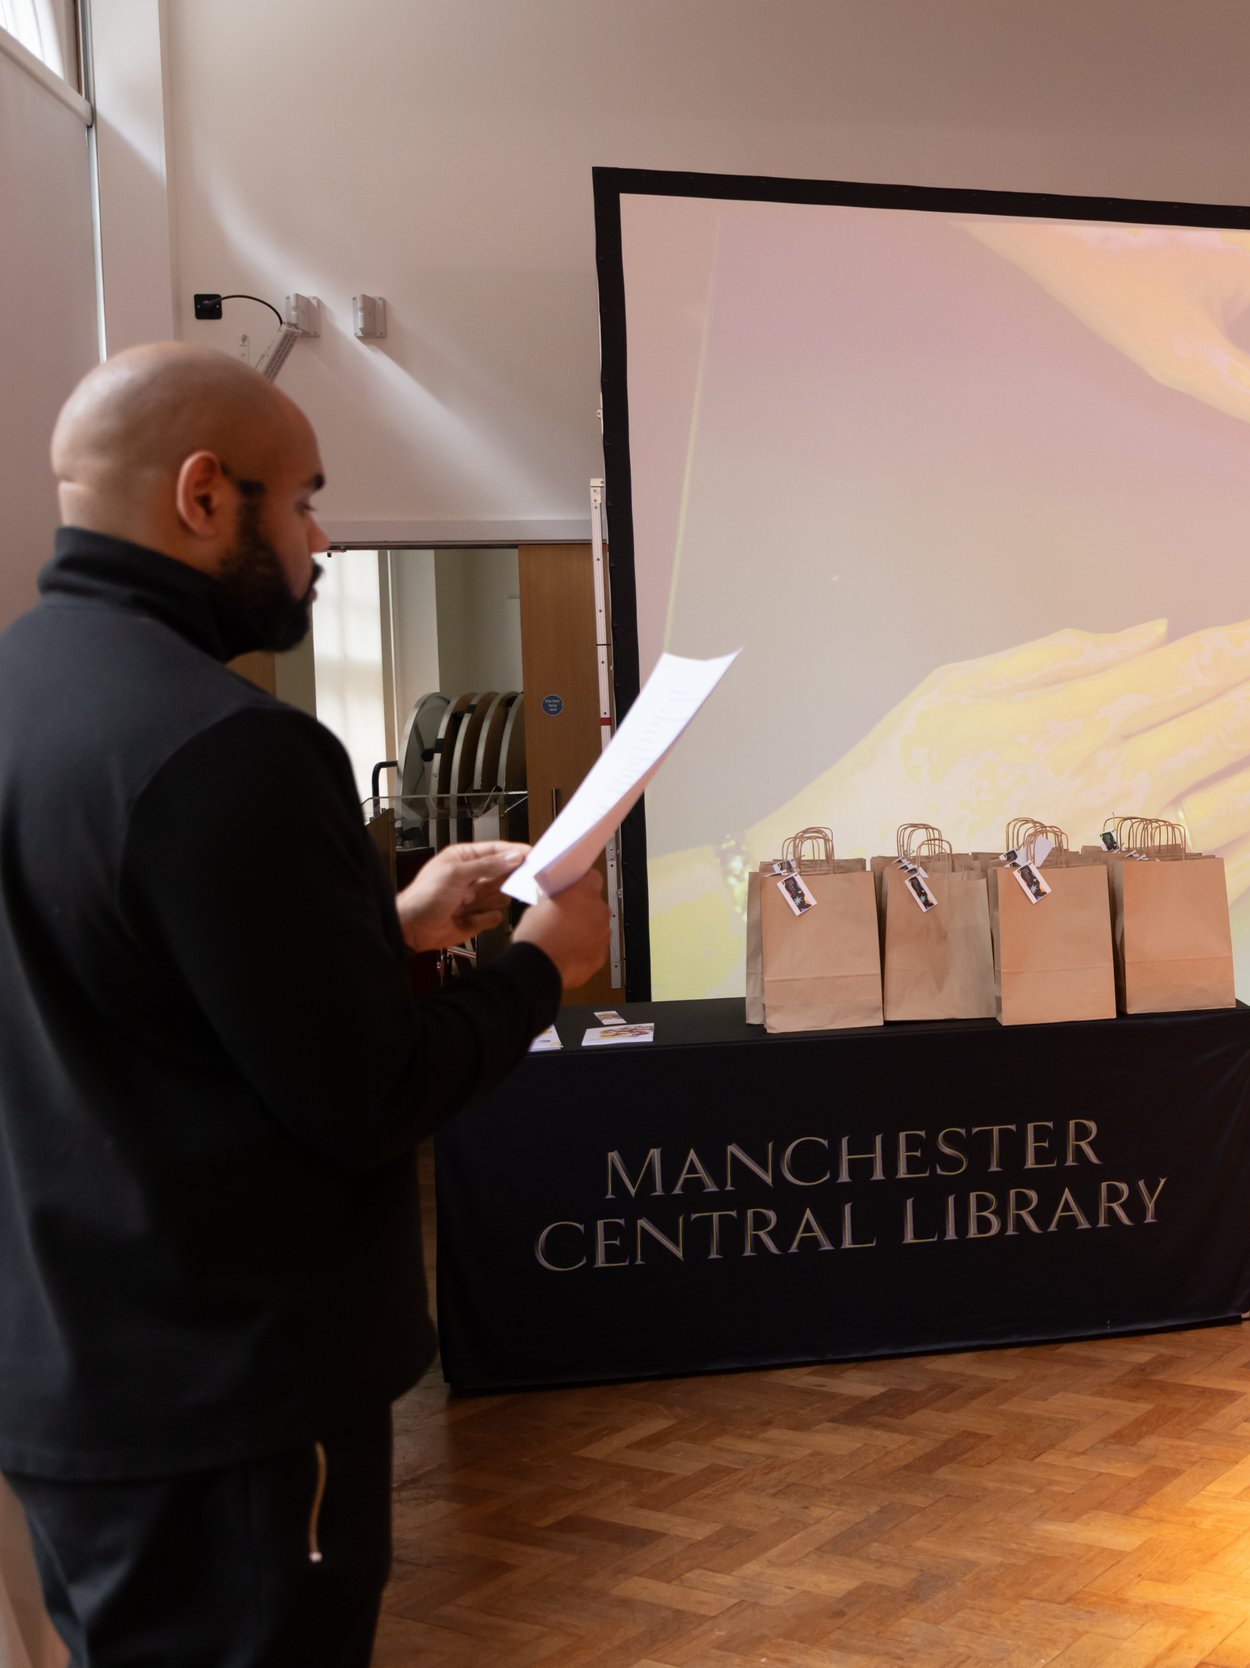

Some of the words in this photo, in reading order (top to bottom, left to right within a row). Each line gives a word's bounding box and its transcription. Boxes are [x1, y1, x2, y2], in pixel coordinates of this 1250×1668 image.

[604, 1118, 1102, 1198] MANCHESTER
[534, 1201, 876, 1271] CENTRAL
[902, 1176, 1168, 1244] LIBRARY
